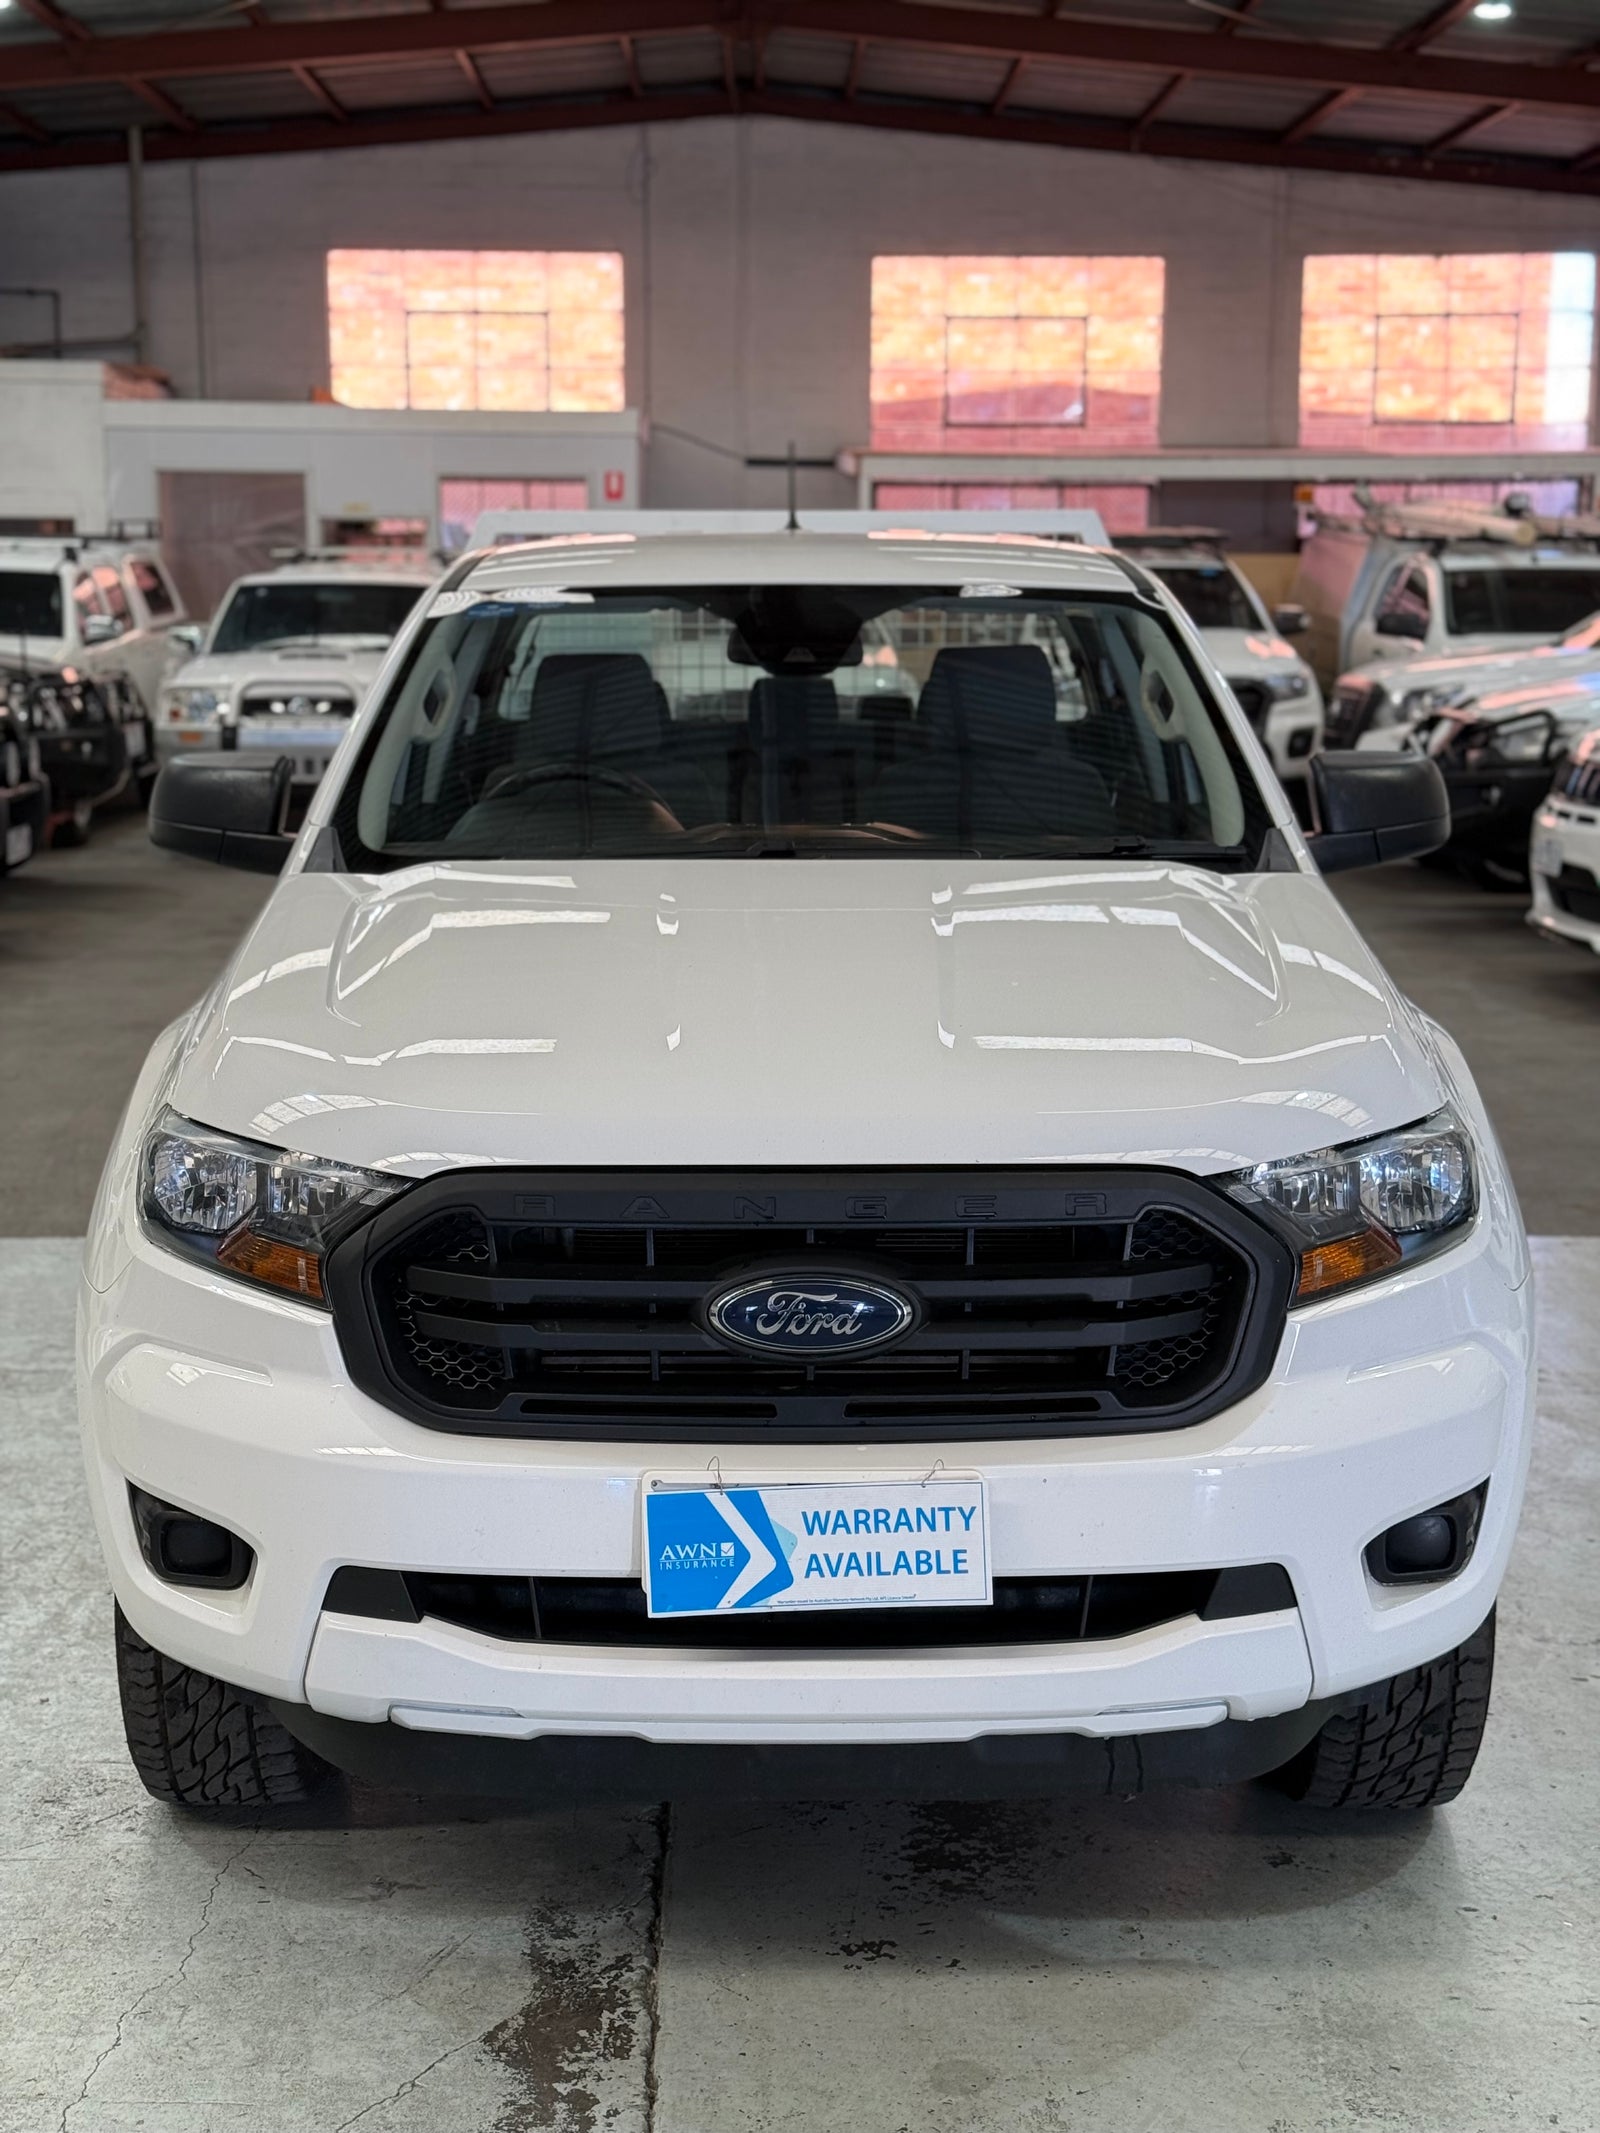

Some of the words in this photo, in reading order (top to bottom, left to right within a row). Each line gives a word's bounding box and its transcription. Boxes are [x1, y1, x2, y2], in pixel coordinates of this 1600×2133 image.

[513, 1193, 1107, 1219] RANGER
[756, 1291, 864, 1335] Ford
[801, 1506, 977, 1536] WARRANTY
[660, 1543, 717, 1560] AWN
[660, 1559, 734, 1570] INSURANCE
[804, 1549, 968, 1578] AVAILABLE
